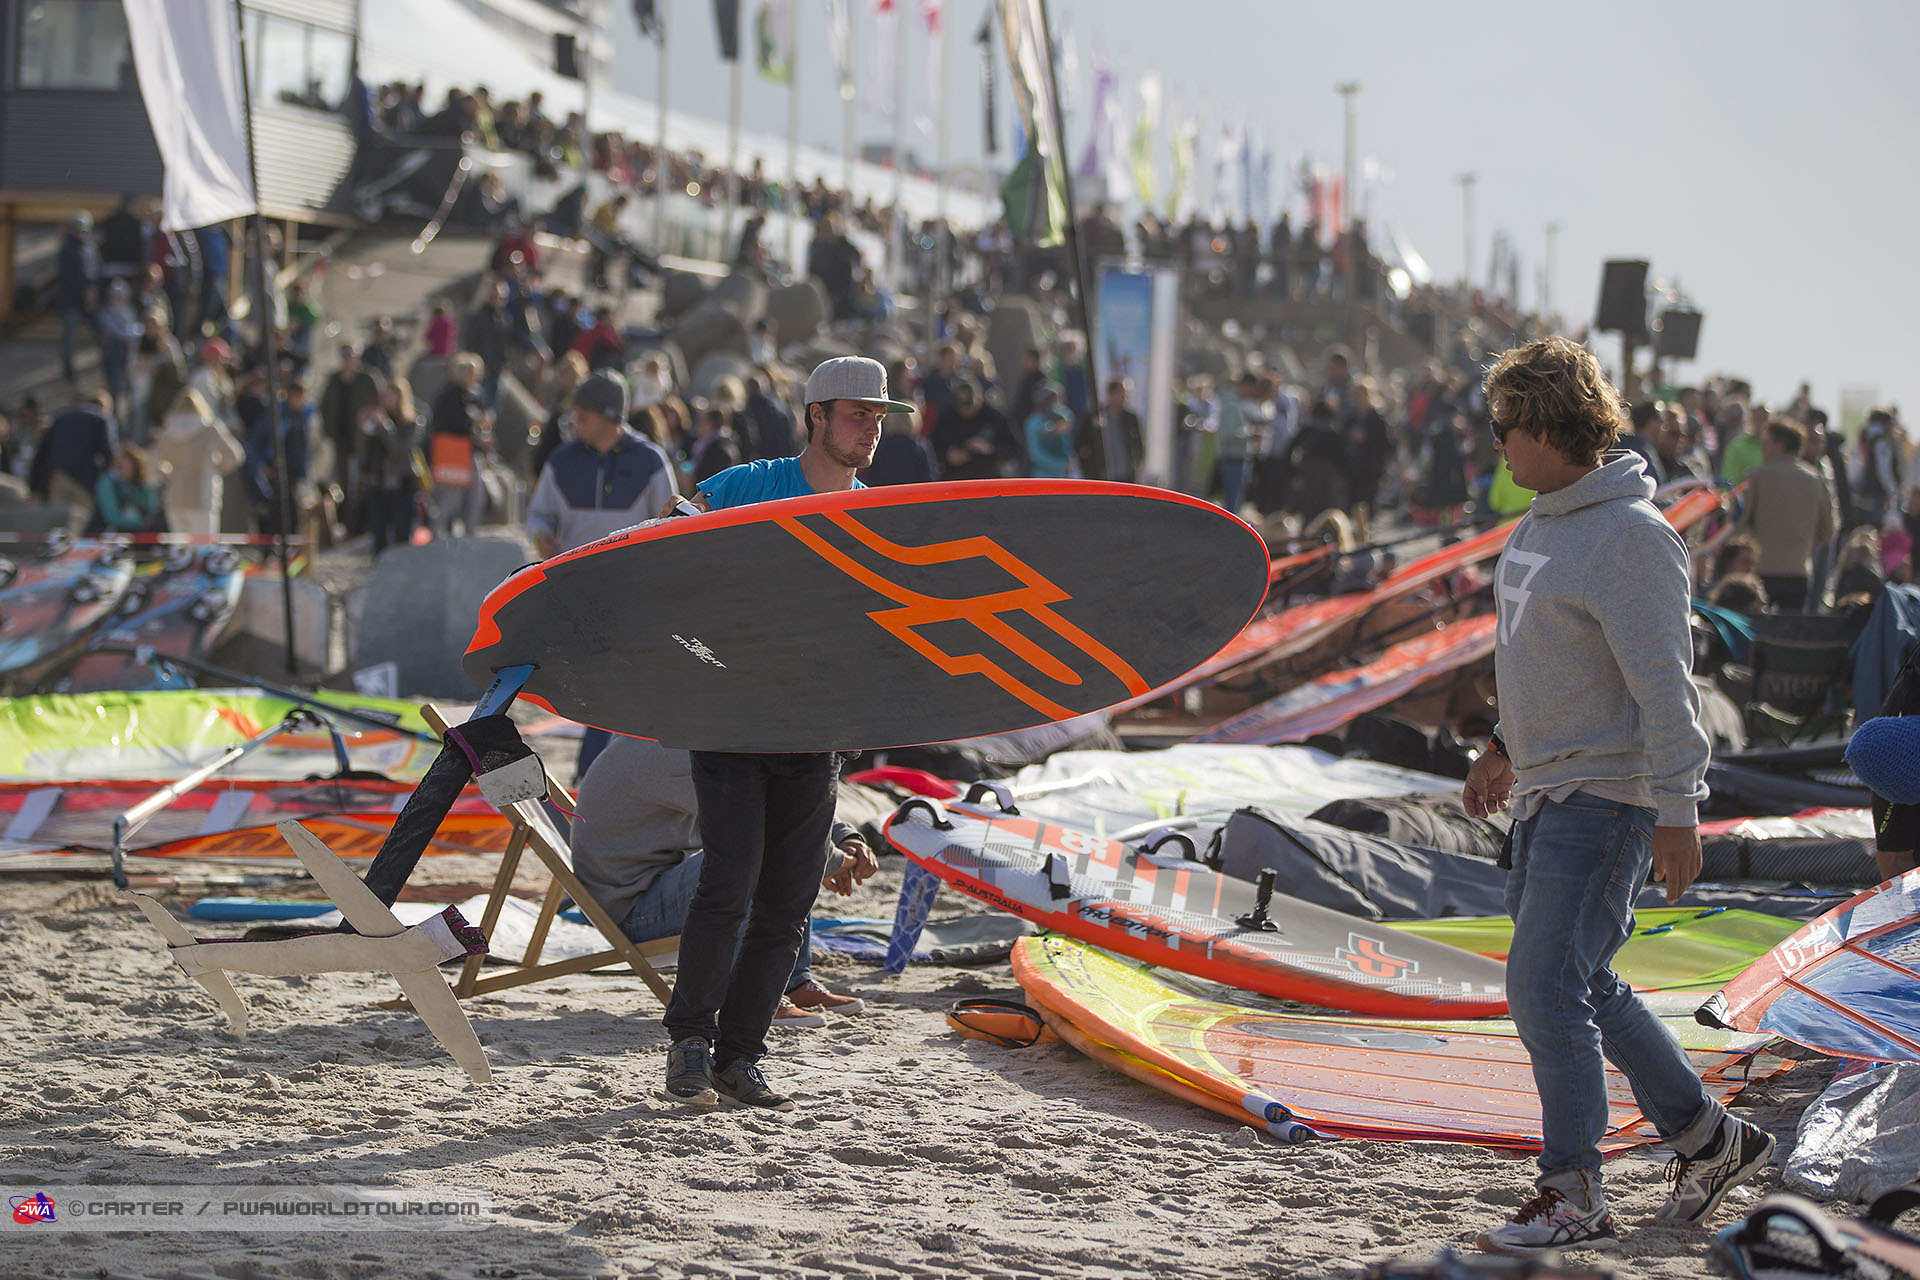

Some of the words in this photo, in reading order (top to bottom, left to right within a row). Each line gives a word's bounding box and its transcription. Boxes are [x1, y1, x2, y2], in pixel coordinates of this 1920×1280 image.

[952, 879, 1024, 914] JP-AUSTRALIA
[1077, 905, 1112, 922] PRO
[1108, 915, 1174, 940] EDITION
